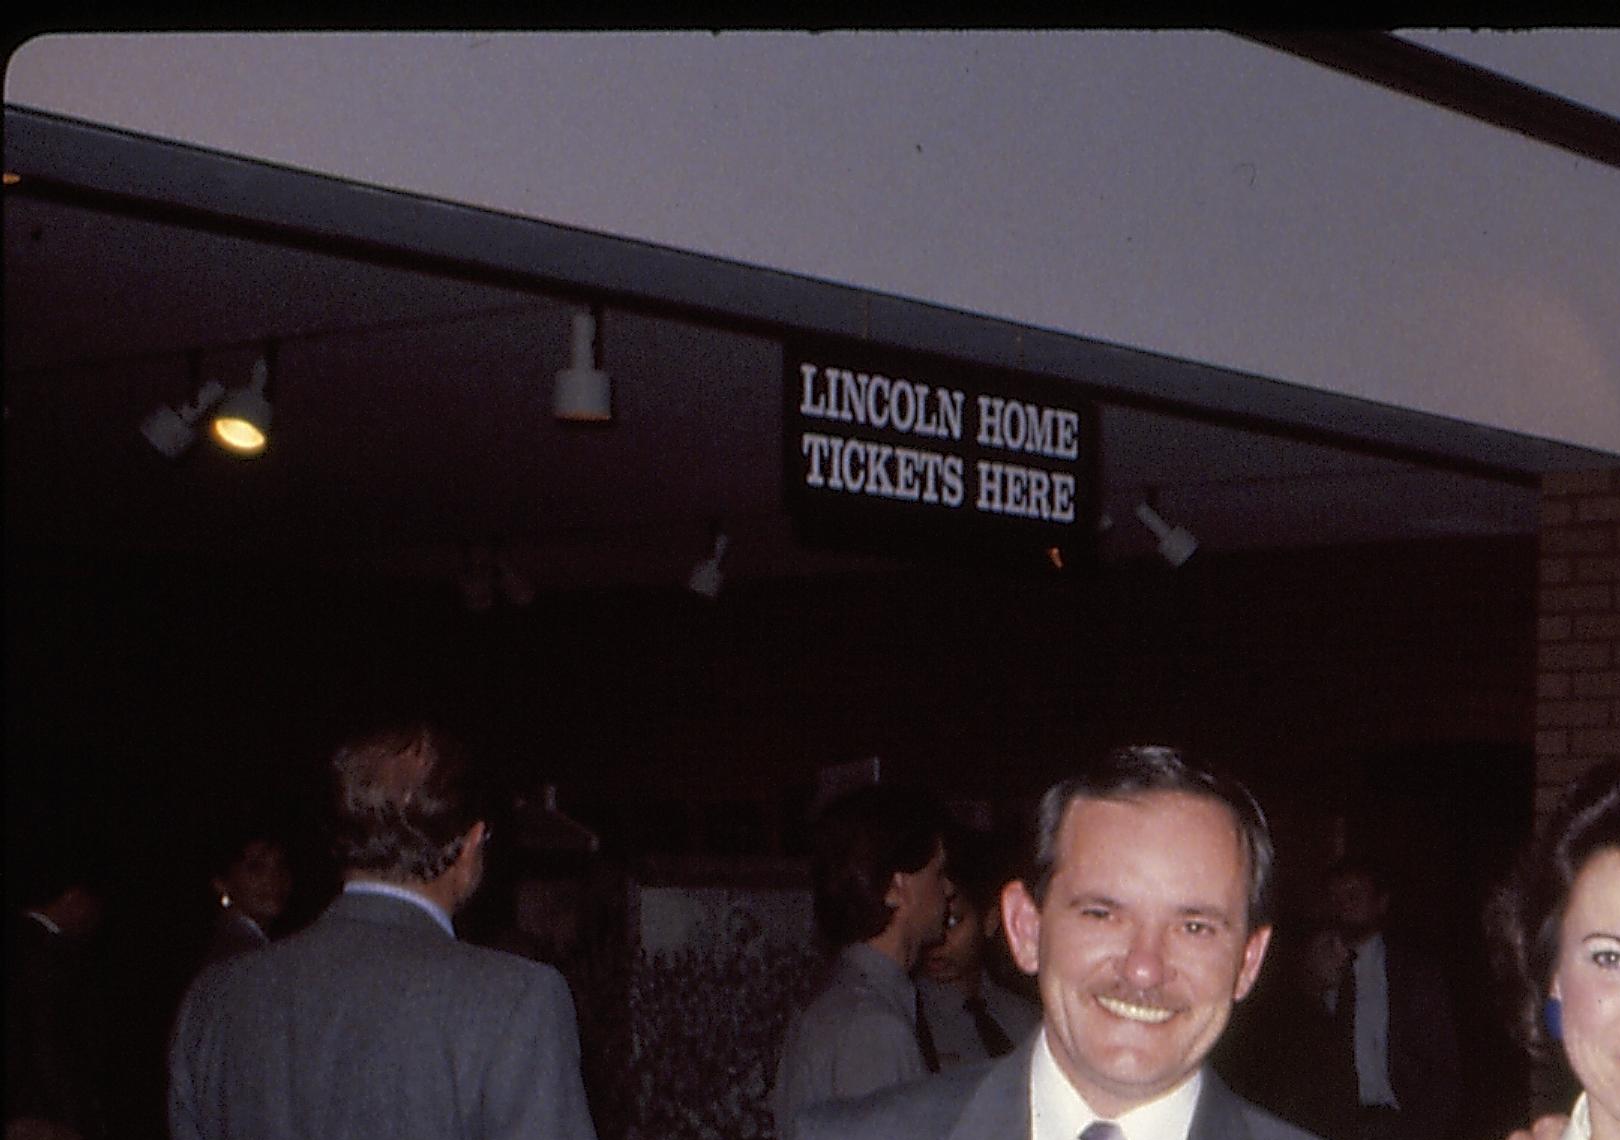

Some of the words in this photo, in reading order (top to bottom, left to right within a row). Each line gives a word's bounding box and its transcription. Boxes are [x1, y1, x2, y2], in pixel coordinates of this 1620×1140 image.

[800, 363, 966, 441] LINCOLN
[976, 394, 1080, 462] HOME
[802, 431, 965, 508] TICKETS
[975, 459, 1076, 524] HERE
